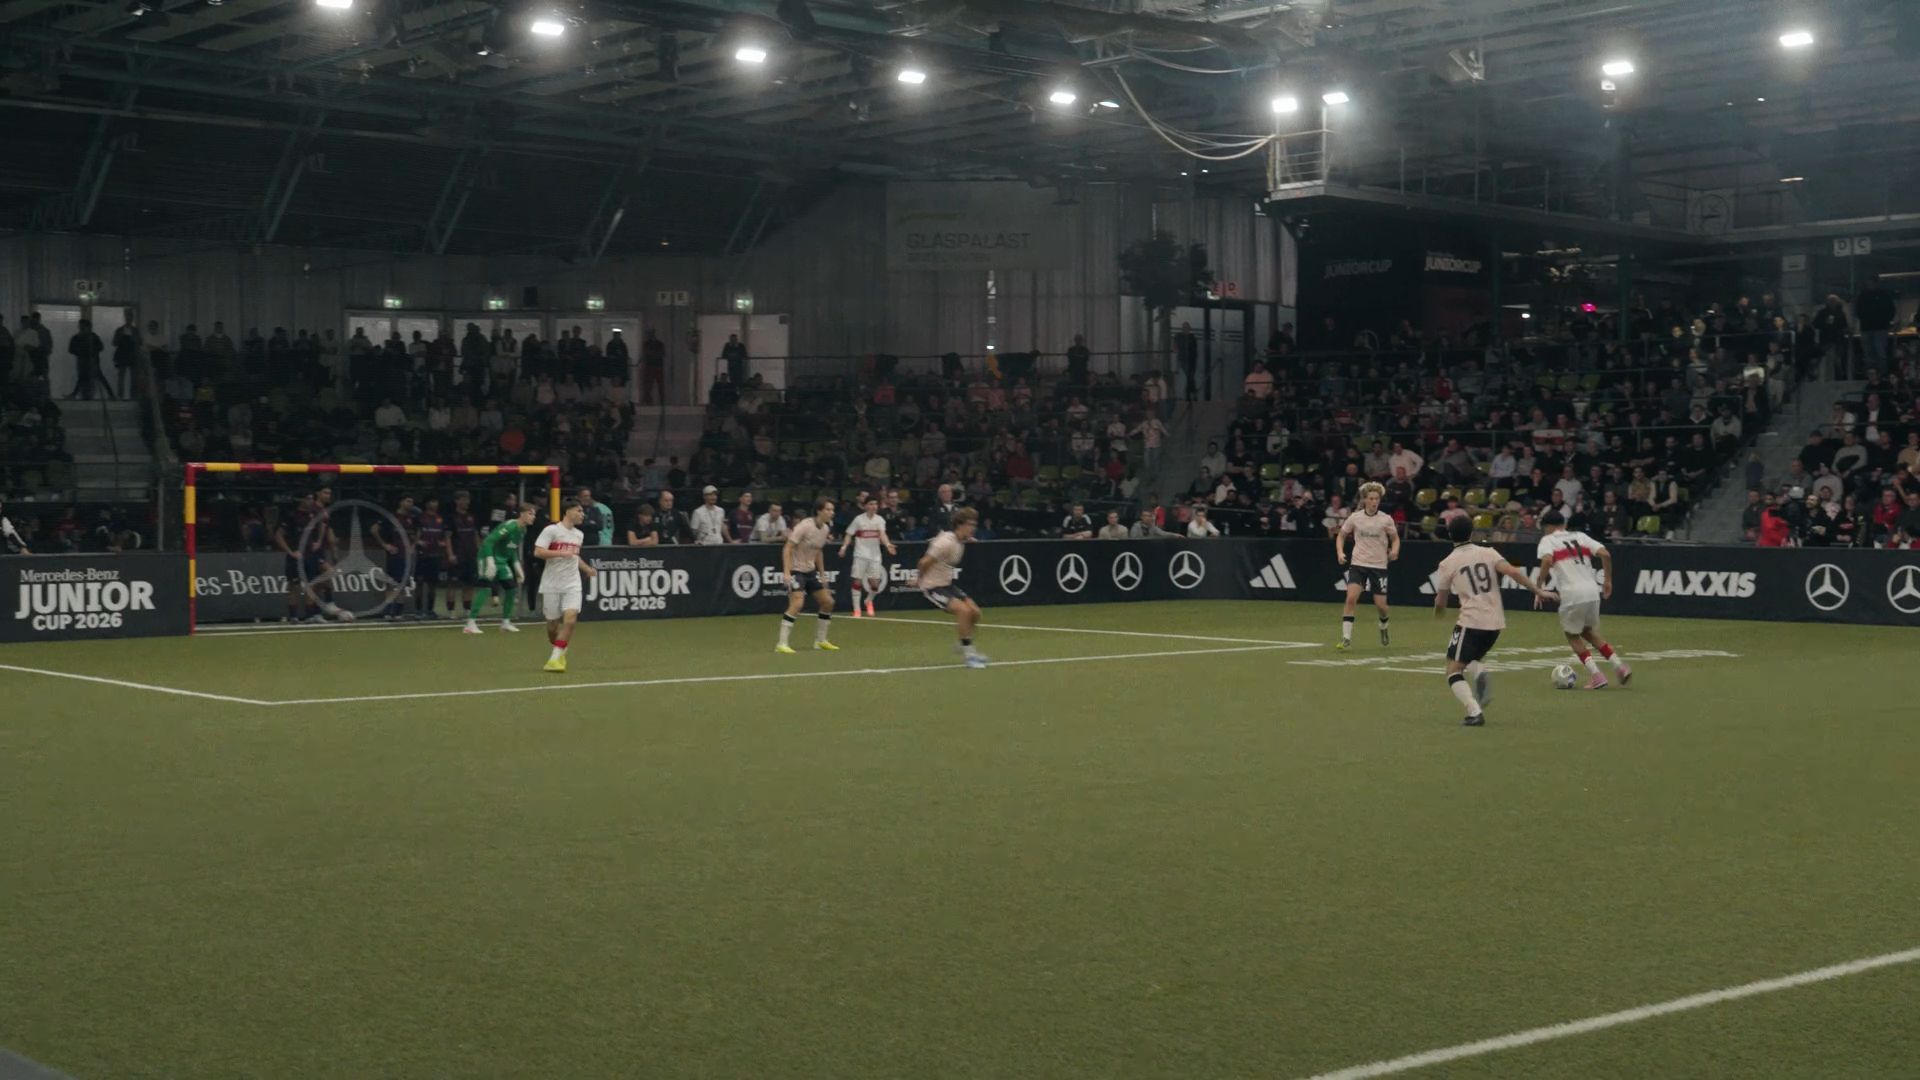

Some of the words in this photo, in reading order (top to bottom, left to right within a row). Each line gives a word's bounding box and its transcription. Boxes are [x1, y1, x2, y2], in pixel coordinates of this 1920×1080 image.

[906, 232, 1031, 249] GLASPALAST
[590, 557, 664, 570] Mercedes-Benz
[20, 568, 120, 582] Mercedes-Benz
[196, 569, 289, 596] es-Benz
[1460, 562, 1492, 595] 19
[1634, 569, 1757, 598] MAXXIS
[586, 569, 691, 602] JUNIOR
[15, 580, 156, 619] JUNIOR
[599, 597, 629, 612] CUP
[630, 597, 667, 611] 2026
[32, 614, 73, 631] CUP
[74, 612, 123, 629] 2026
